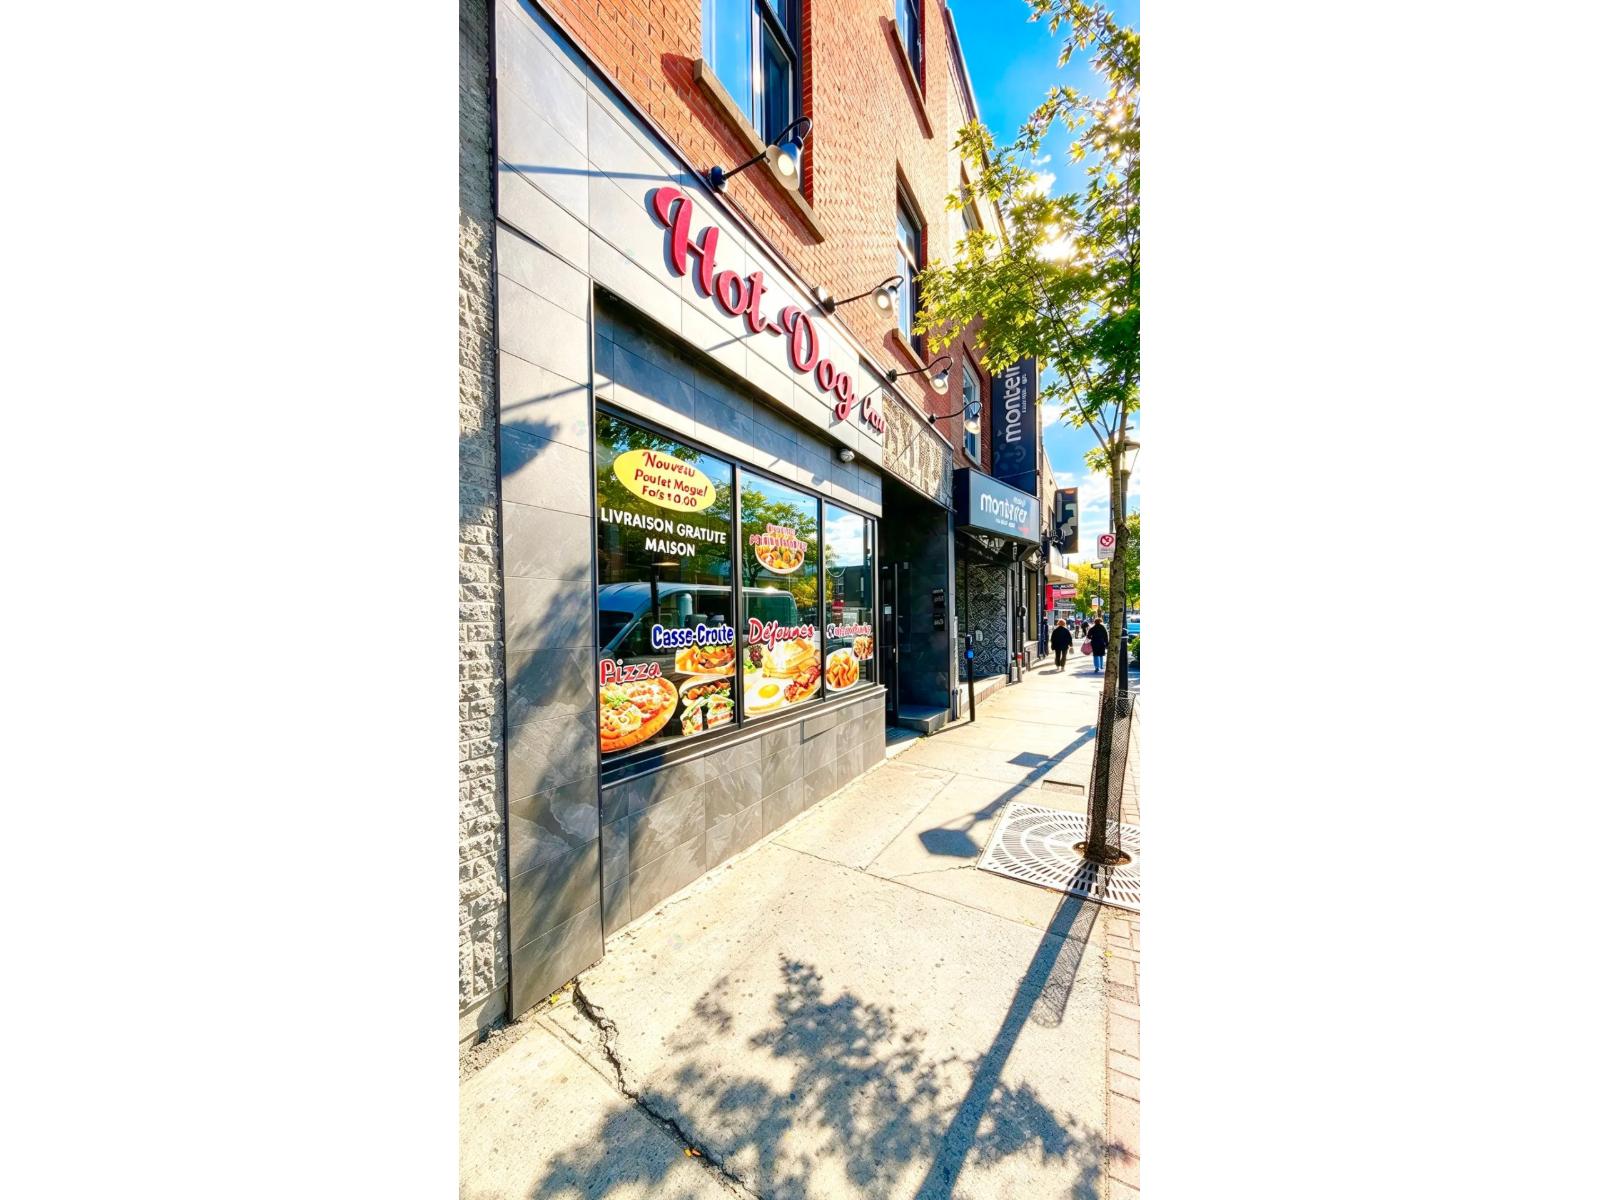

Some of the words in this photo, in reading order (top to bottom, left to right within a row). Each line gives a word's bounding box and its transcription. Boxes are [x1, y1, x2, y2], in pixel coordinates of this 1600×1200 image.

[653, 186, 860, 421] Hot-Dog
[601, 507, 674, 534] LIVRAISON
[645, 537, 695, 557] MAISON
[600, 659, 662, 686] Pizza
